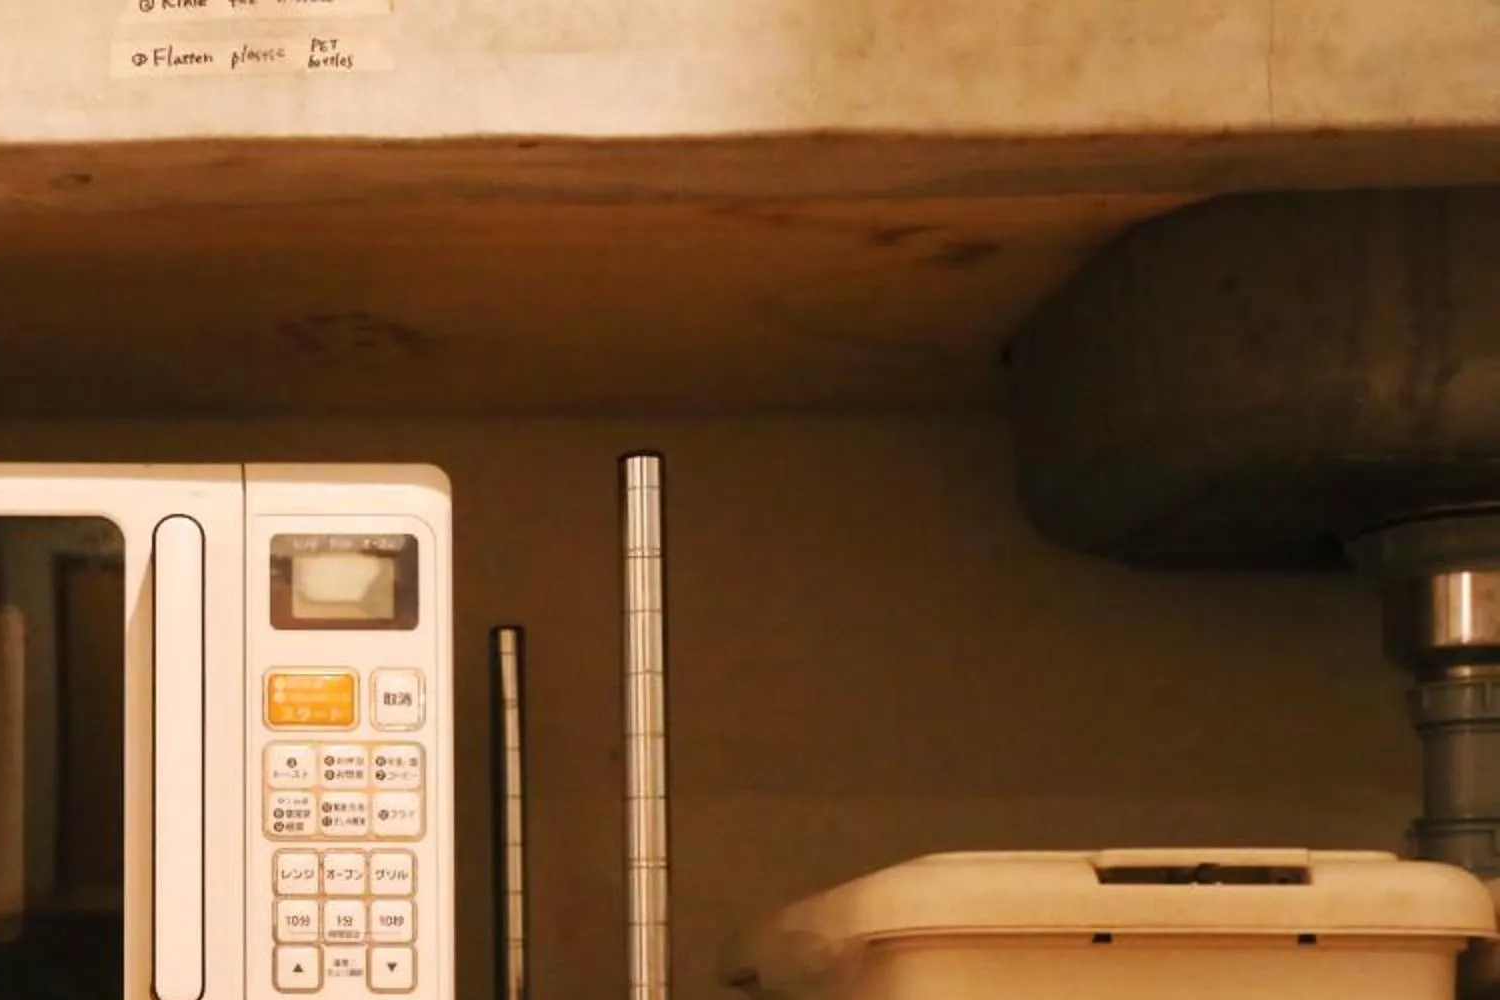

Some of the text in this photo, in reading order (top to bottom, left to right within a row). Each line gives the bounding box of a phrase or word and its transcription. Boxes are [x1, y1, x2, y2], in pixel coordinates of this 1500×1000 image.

[311, 38, 339, 52] PET
[153, 45, 213, 67] Flatten
[383, 692, 413, 707] 取消
[281, 869, 315, 880] レンジ
[326, 869, 363, 881] オーブン
[375, 869, 409, 880] グリル
[286, 915, 311, 927] 10分
[337, 915, 353, 927] 1分
